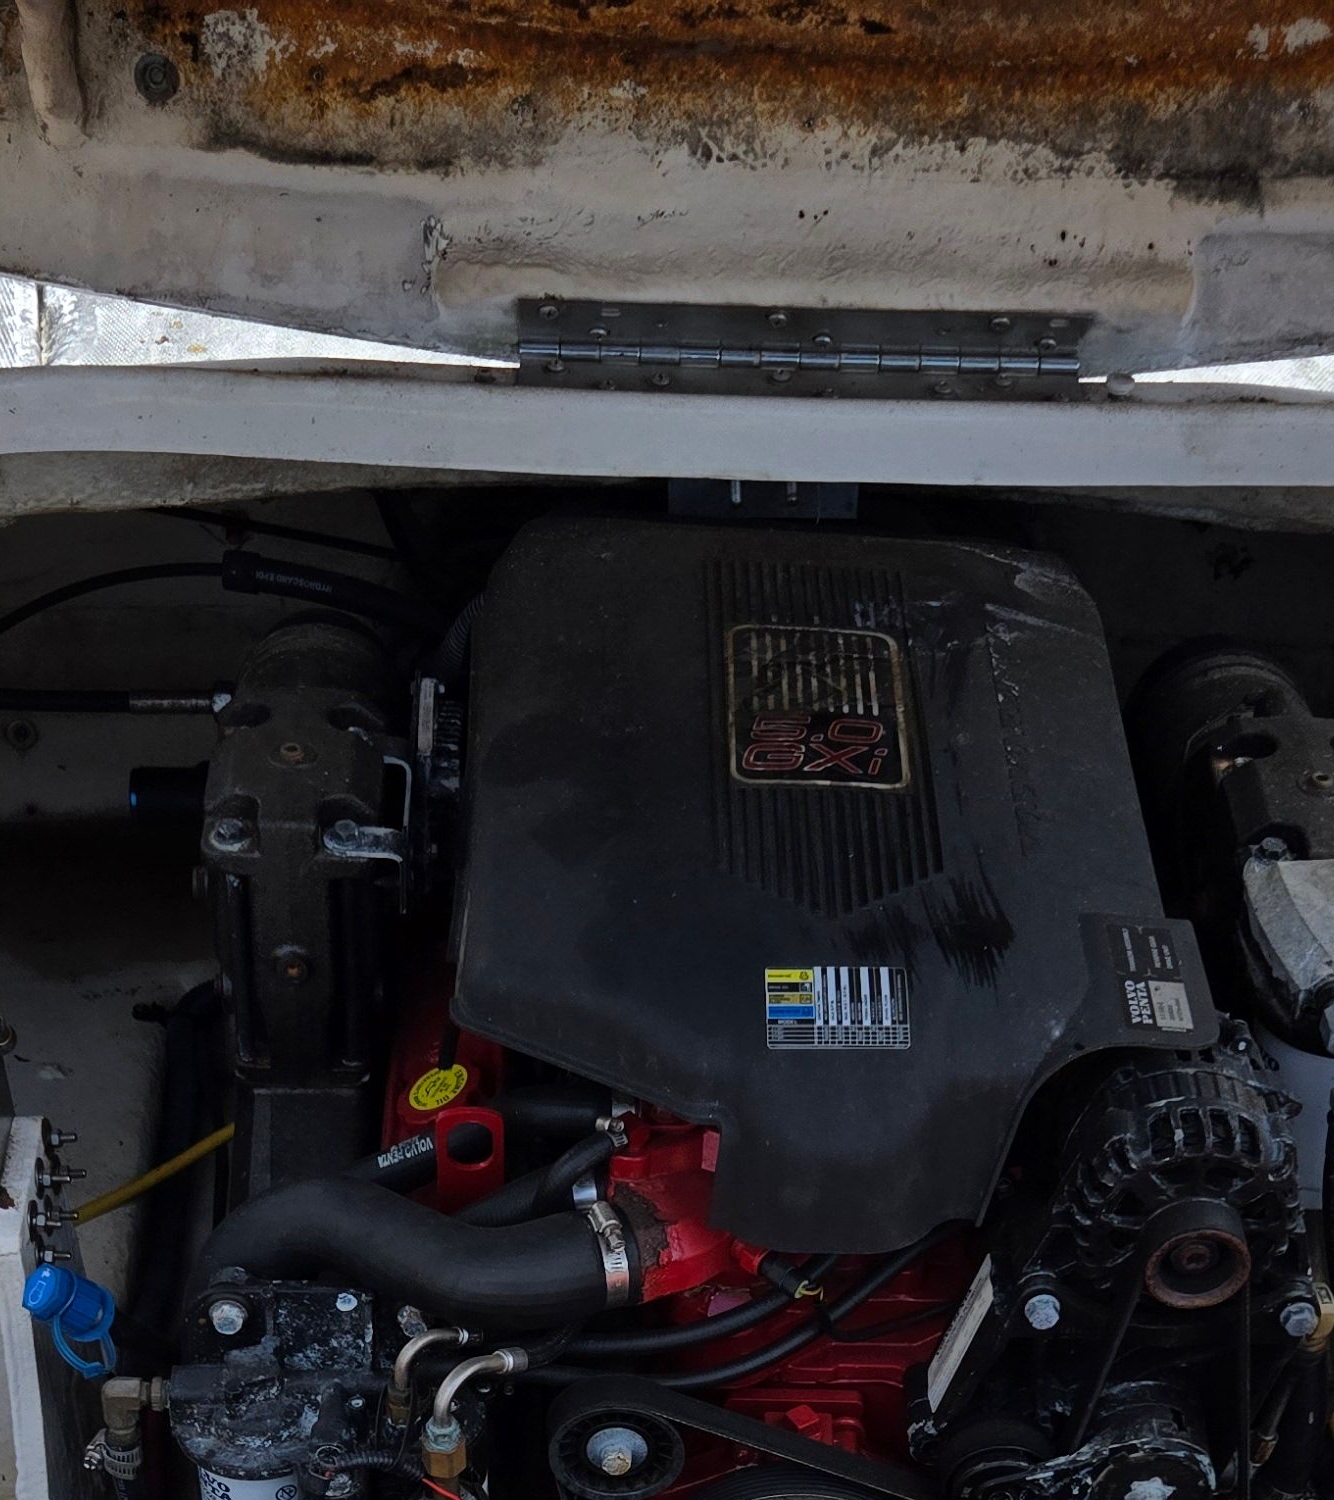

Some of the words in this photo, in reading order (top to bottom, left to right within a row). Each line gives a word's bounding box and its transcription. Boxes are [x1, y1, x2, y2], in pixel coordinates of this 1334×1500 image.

[749, 714, 885, 745] 5.0
[740, 741, 889, 776] GXi
[1123, 979, 1142, 1024] VOLVO
[1135, 981, 1154, 1025] PENTA
[404, 1137, 434, 1158] VOLVO
